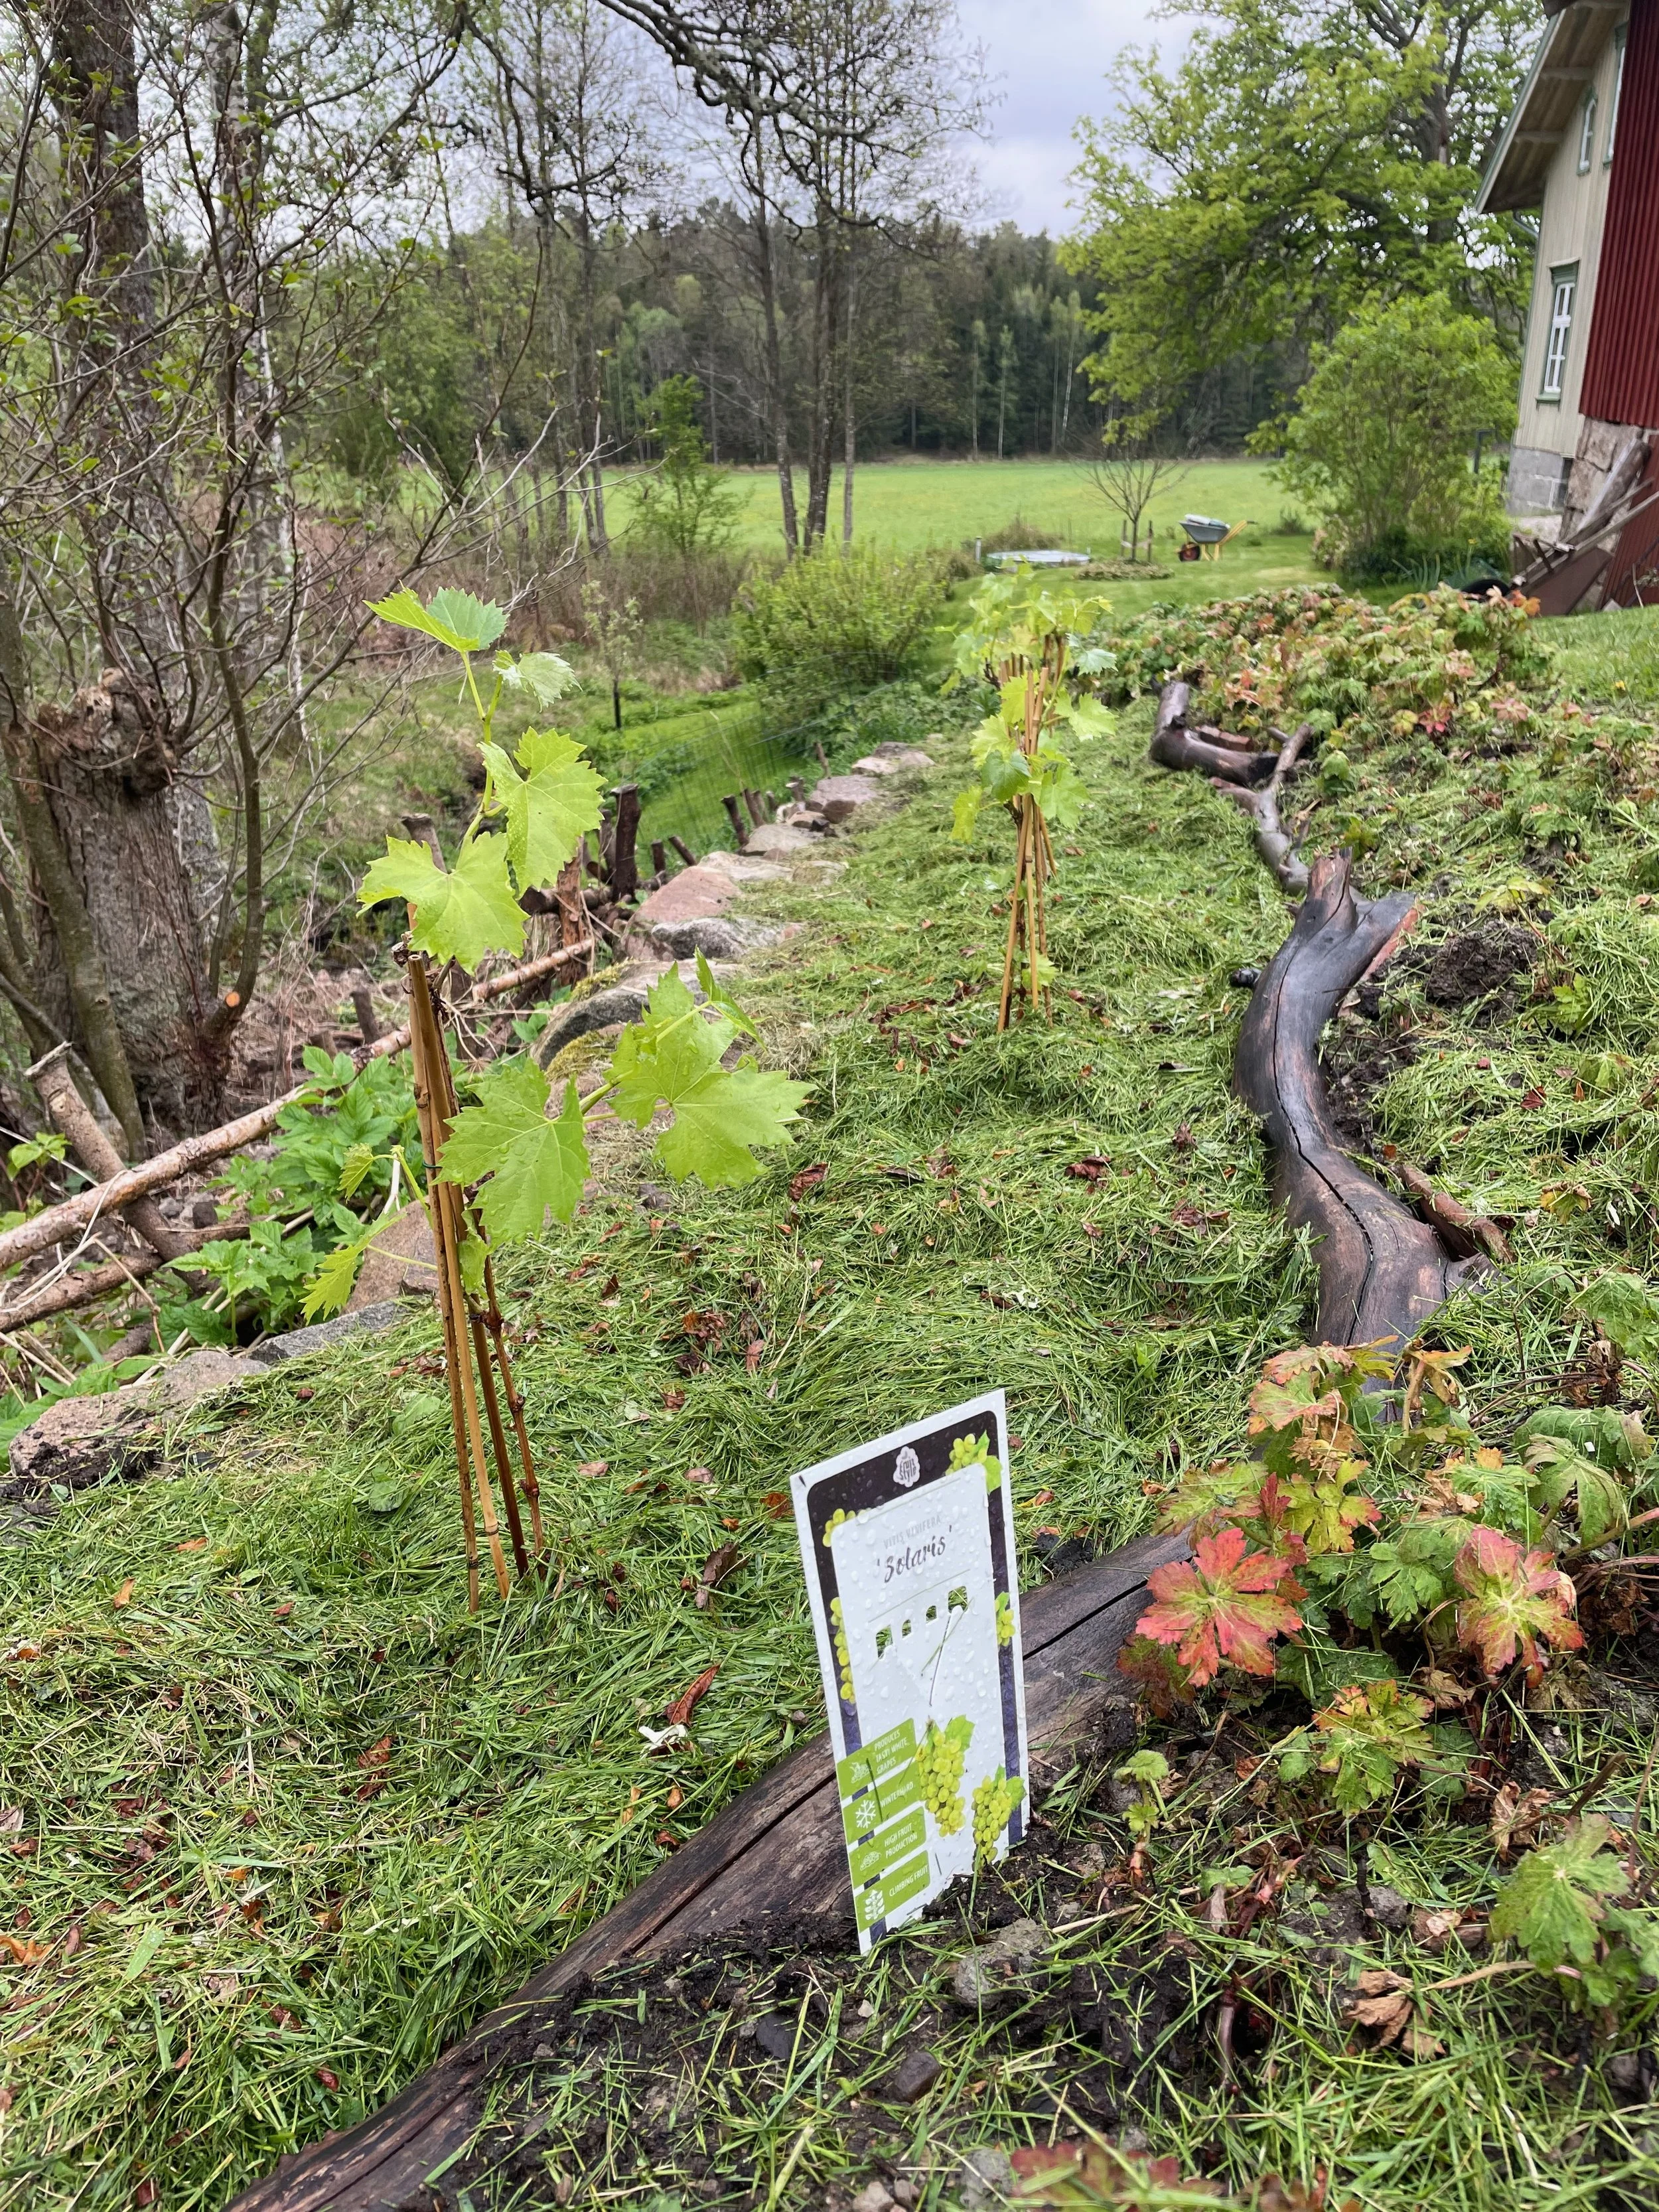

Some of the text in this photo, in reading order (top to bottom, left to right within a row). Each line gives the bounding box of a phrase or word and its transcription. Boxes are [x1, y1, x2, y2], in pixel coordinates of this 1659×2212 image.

[883, 1532, 904, 1549] VITIS
[875, 1729, 901, 1751] PRODUCES
[876, 1737, 908, 1763] TASTY WHITE
[877, 1757, 896, 1774] GRAPES
[880, 1781, 913, 1808] WINTERHARD
[885, 1822, 912, 1847] HIGH FRUIT
[885, 1832, 917, 1858] PRODUCTION
[889, 1864, 928, 1897] CLIMBING FRUIT
